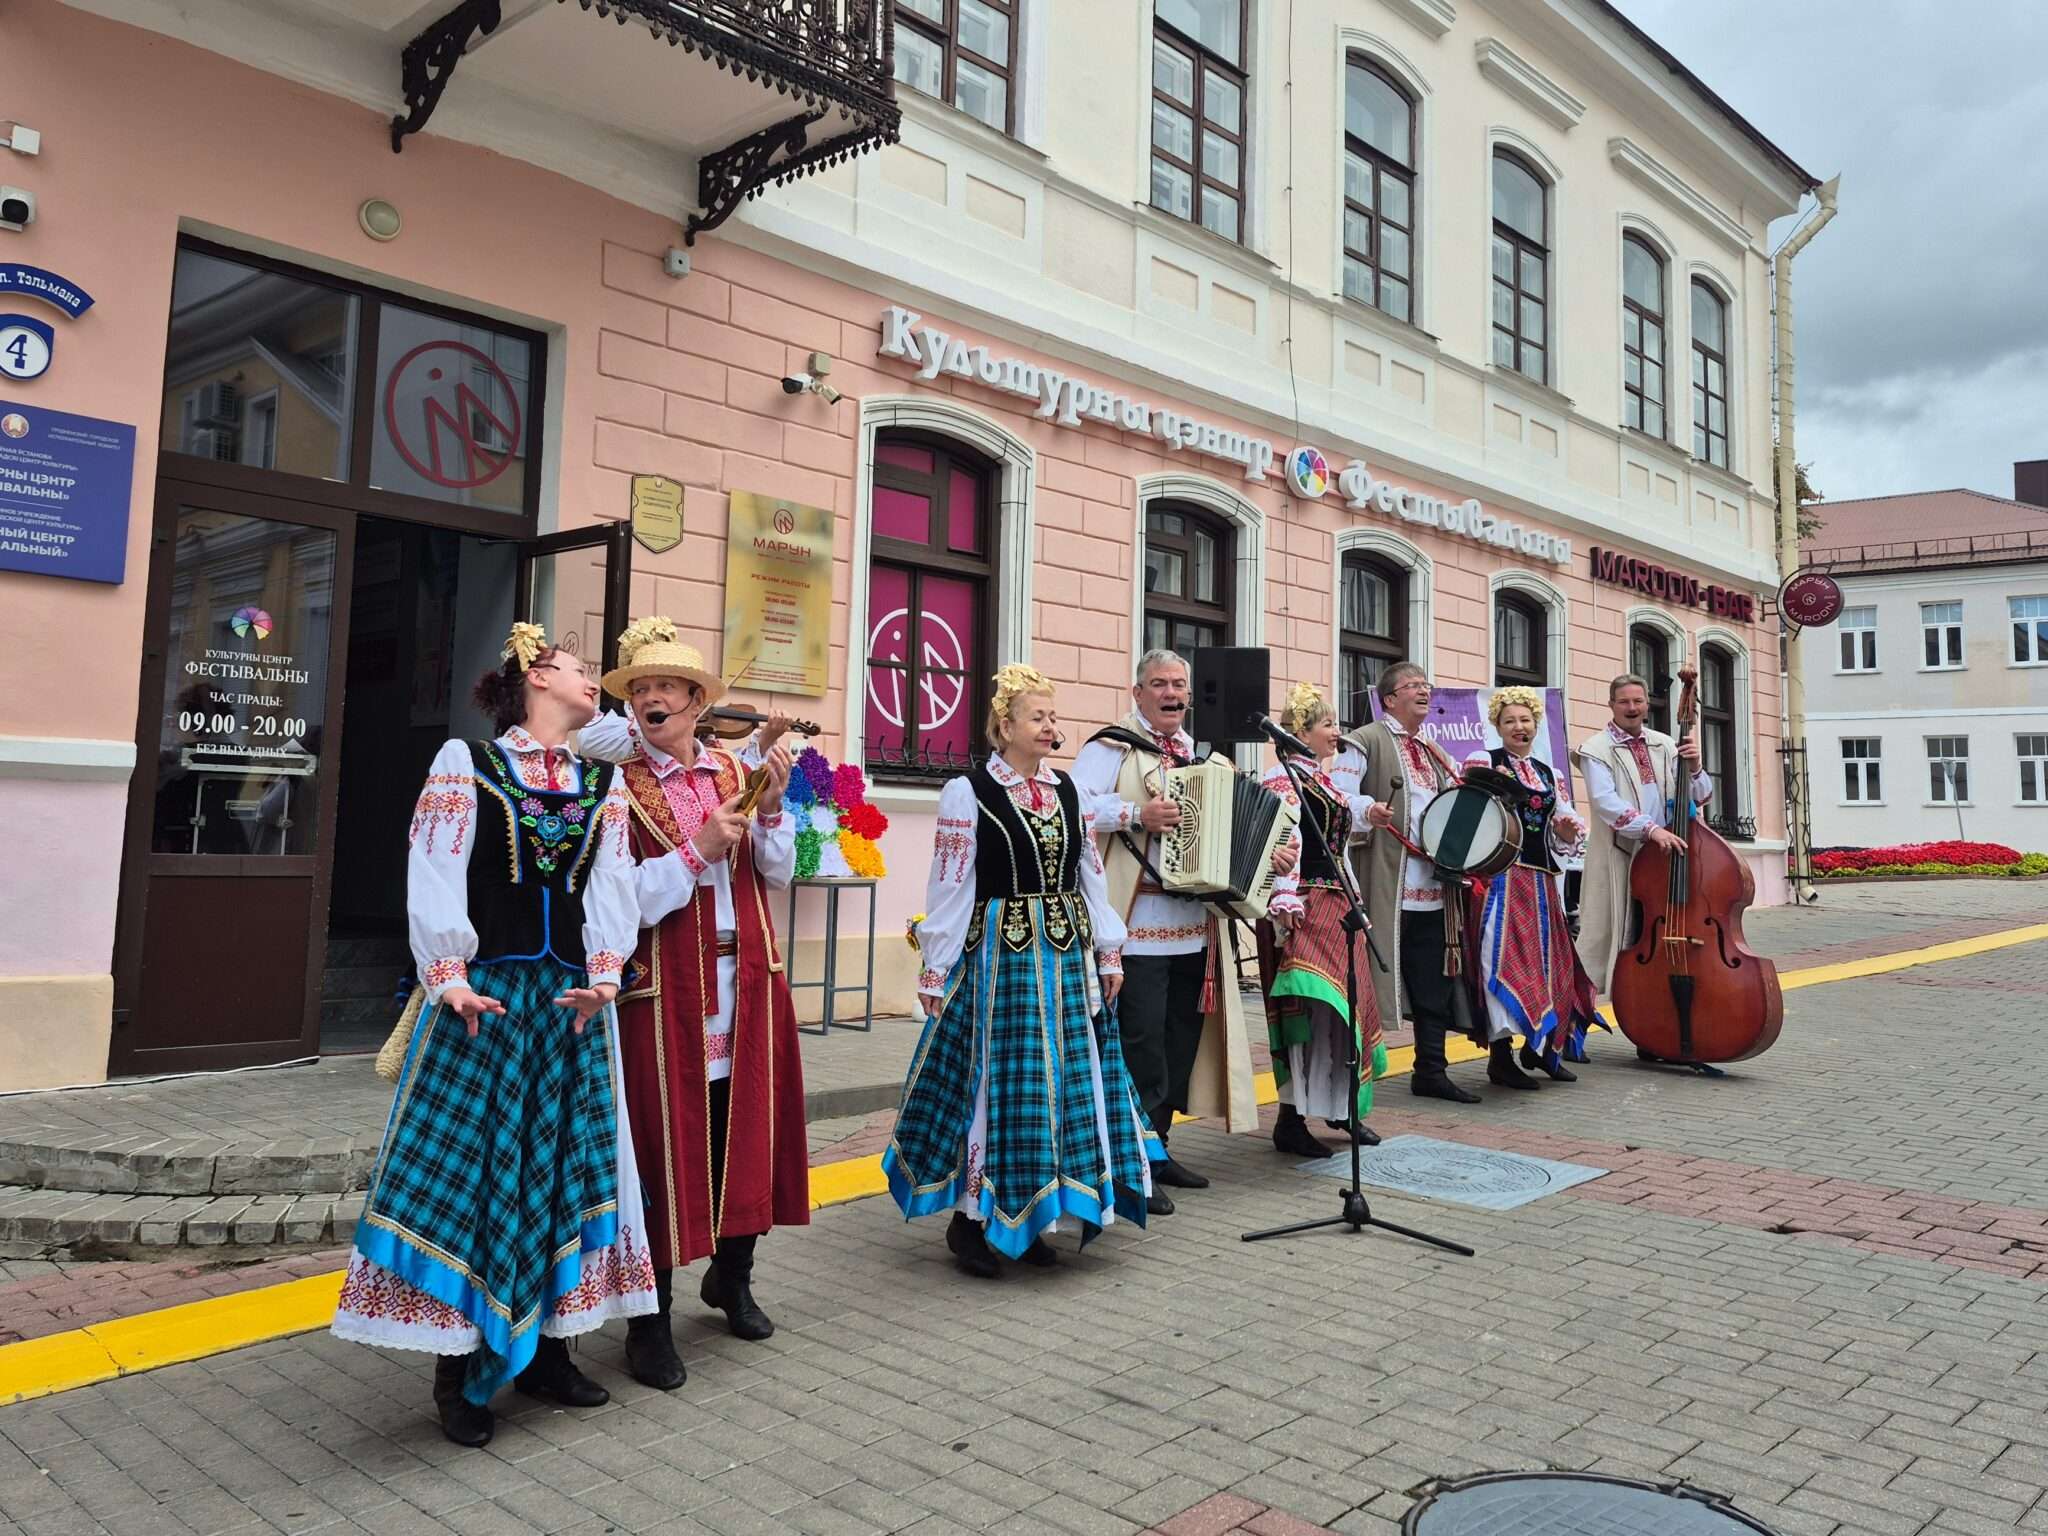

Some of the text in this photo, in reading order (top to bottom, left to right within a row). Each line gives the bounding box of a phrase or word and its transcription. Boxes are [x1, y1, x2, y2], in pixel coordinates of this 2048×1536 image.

[17, 271, 81, 307] Тэльмана
[6, 334, 28, 369] 4
[877, 305, 1273, 481] Культурны цэнтр
[30, 472, 76, 488] ЦЭНТР
[1339, 460, 1571, 564] Фестывальны
[30, 531, 76, 545] ЦЕНТР
[753, 537, 811, 558] МАРУН
[1790, 577, 1831, 592] МАРУН
[1789, 601, 1835, 622] MAROON
[205, 649, 293, 666] КУЛЬТУРНЫ ЦЭНТР
[185, 661, 309, 684] ФЕСТЫВАЛЬНЫ
[210, 691, 284, 708] ЧАС ПРАЦЫ:
[179, 711, 235, 734] 09.00
[253, 715, 307, 738] 20.00
[1419, 715, 1485, 741] но-микс
[196, 743, 217, 754] БЕЗ
